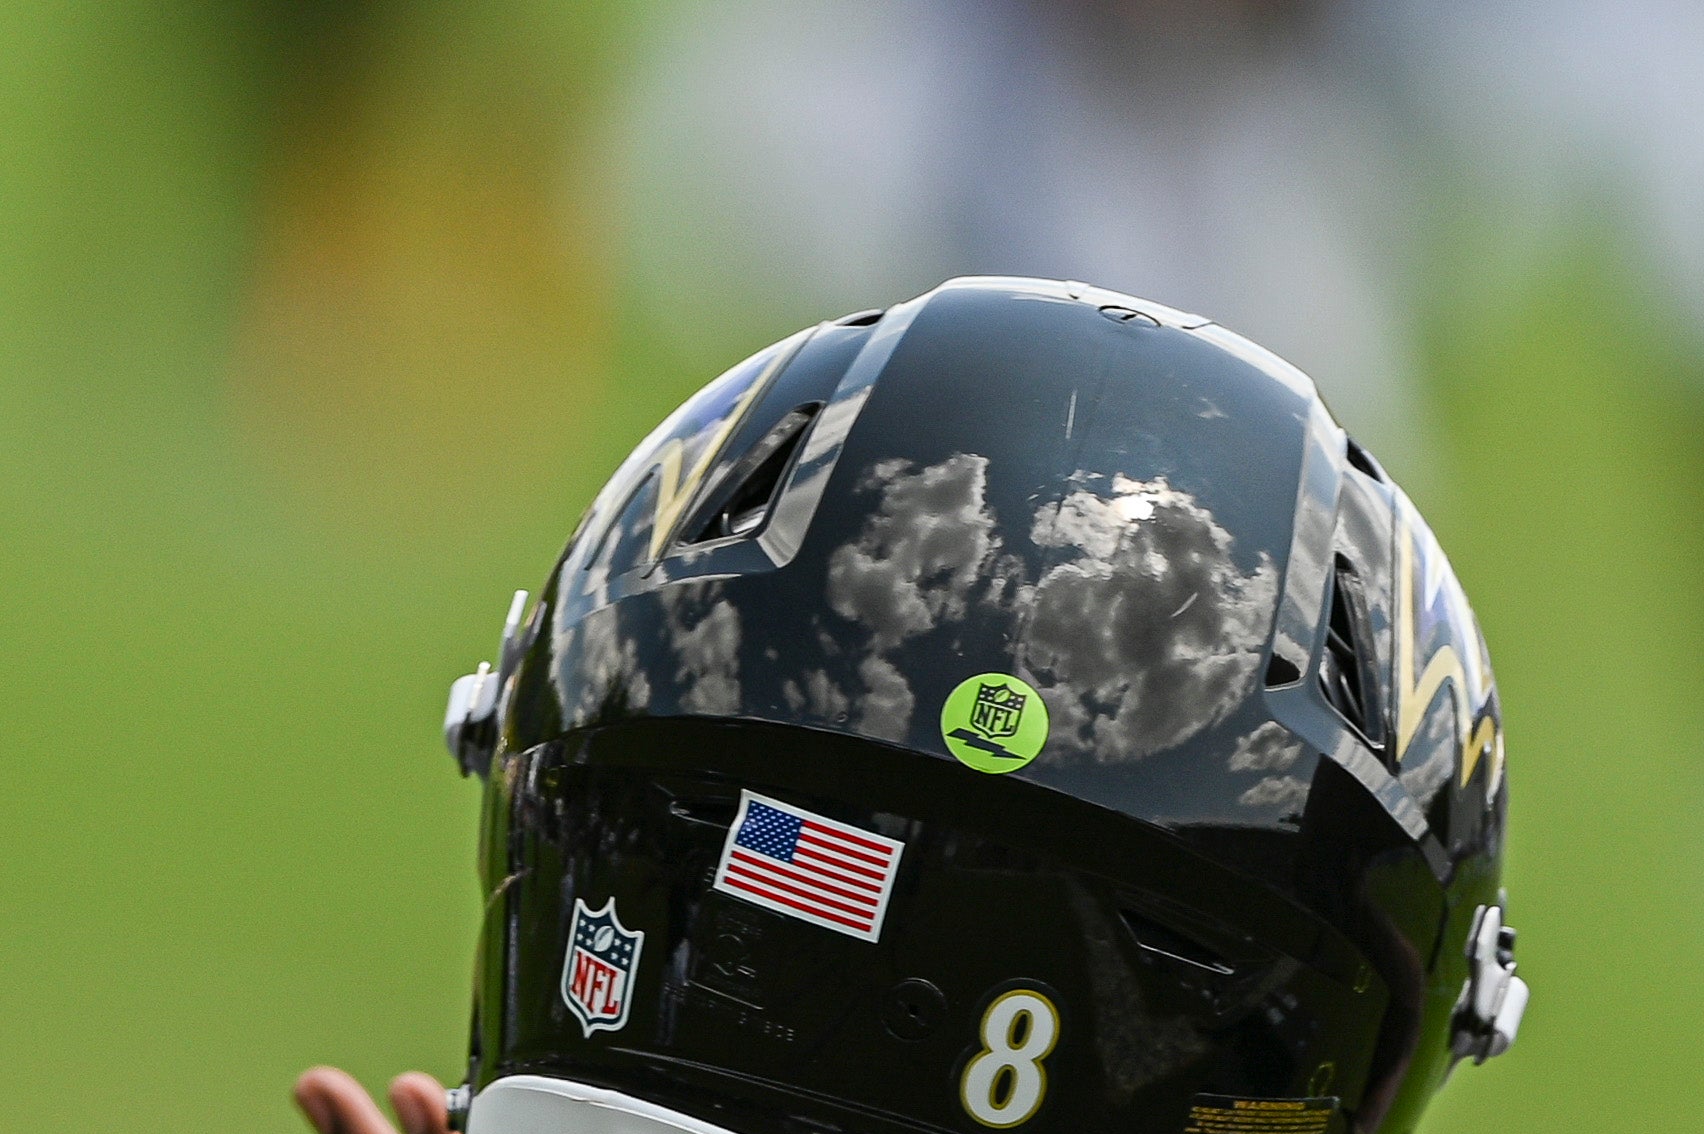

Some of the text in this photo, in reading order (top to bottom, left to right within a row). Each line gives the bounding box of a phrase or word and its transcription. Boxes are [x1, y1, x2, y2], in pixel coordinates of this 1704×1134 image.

[973, 702, 1015, 733] NFL
[570, 950, 619, 1015] NFL
[958, 989, 1061, 1129] 8
